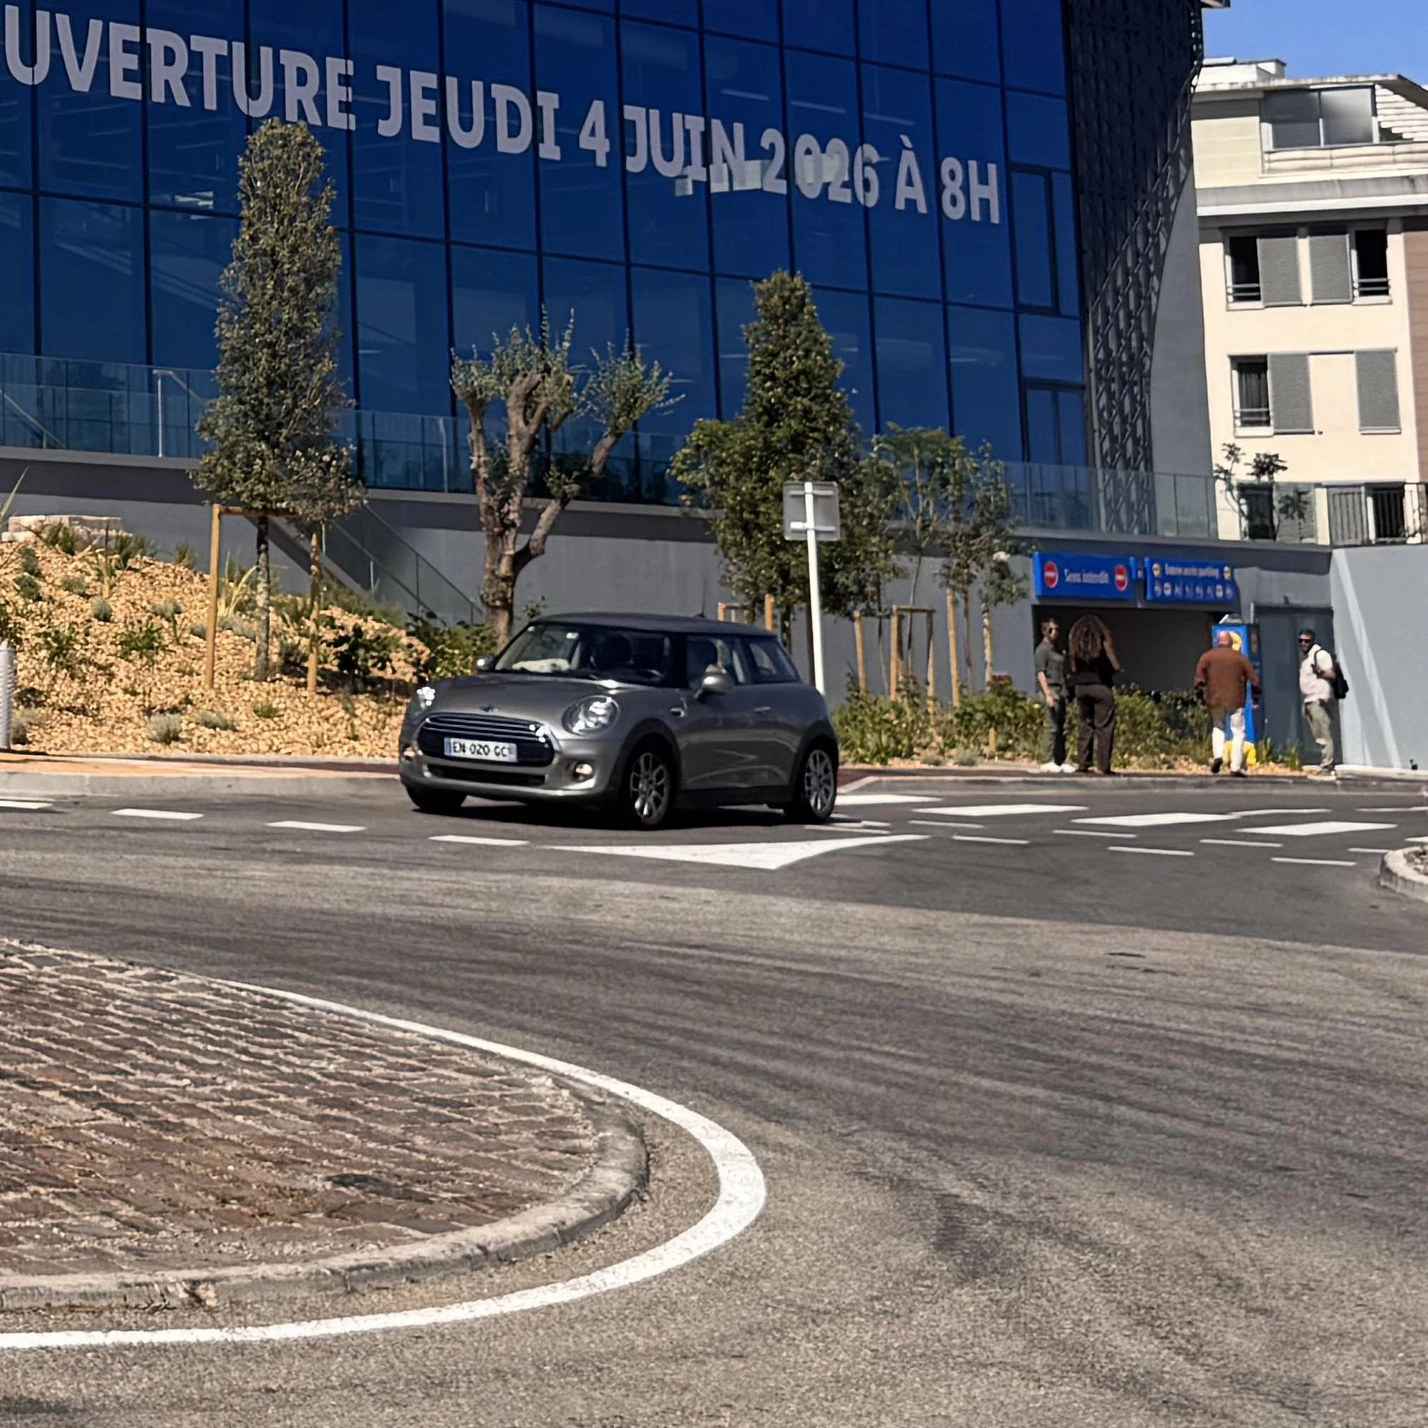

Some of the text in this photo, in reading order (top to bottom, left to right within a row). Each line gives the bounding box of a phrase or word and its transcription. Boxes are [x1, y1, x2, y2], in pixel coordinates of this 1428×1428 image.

[377, 65, 561, 161] JEUDI
[579, 99, 611, 168] 4
[623, 105, 745, 190] JUIN
[760, 128, 880, 208] 2026
[895, 134, 928, 214] À
[940, 157, 1001, 224] 8H
[469, 743, 491, 756] 020
